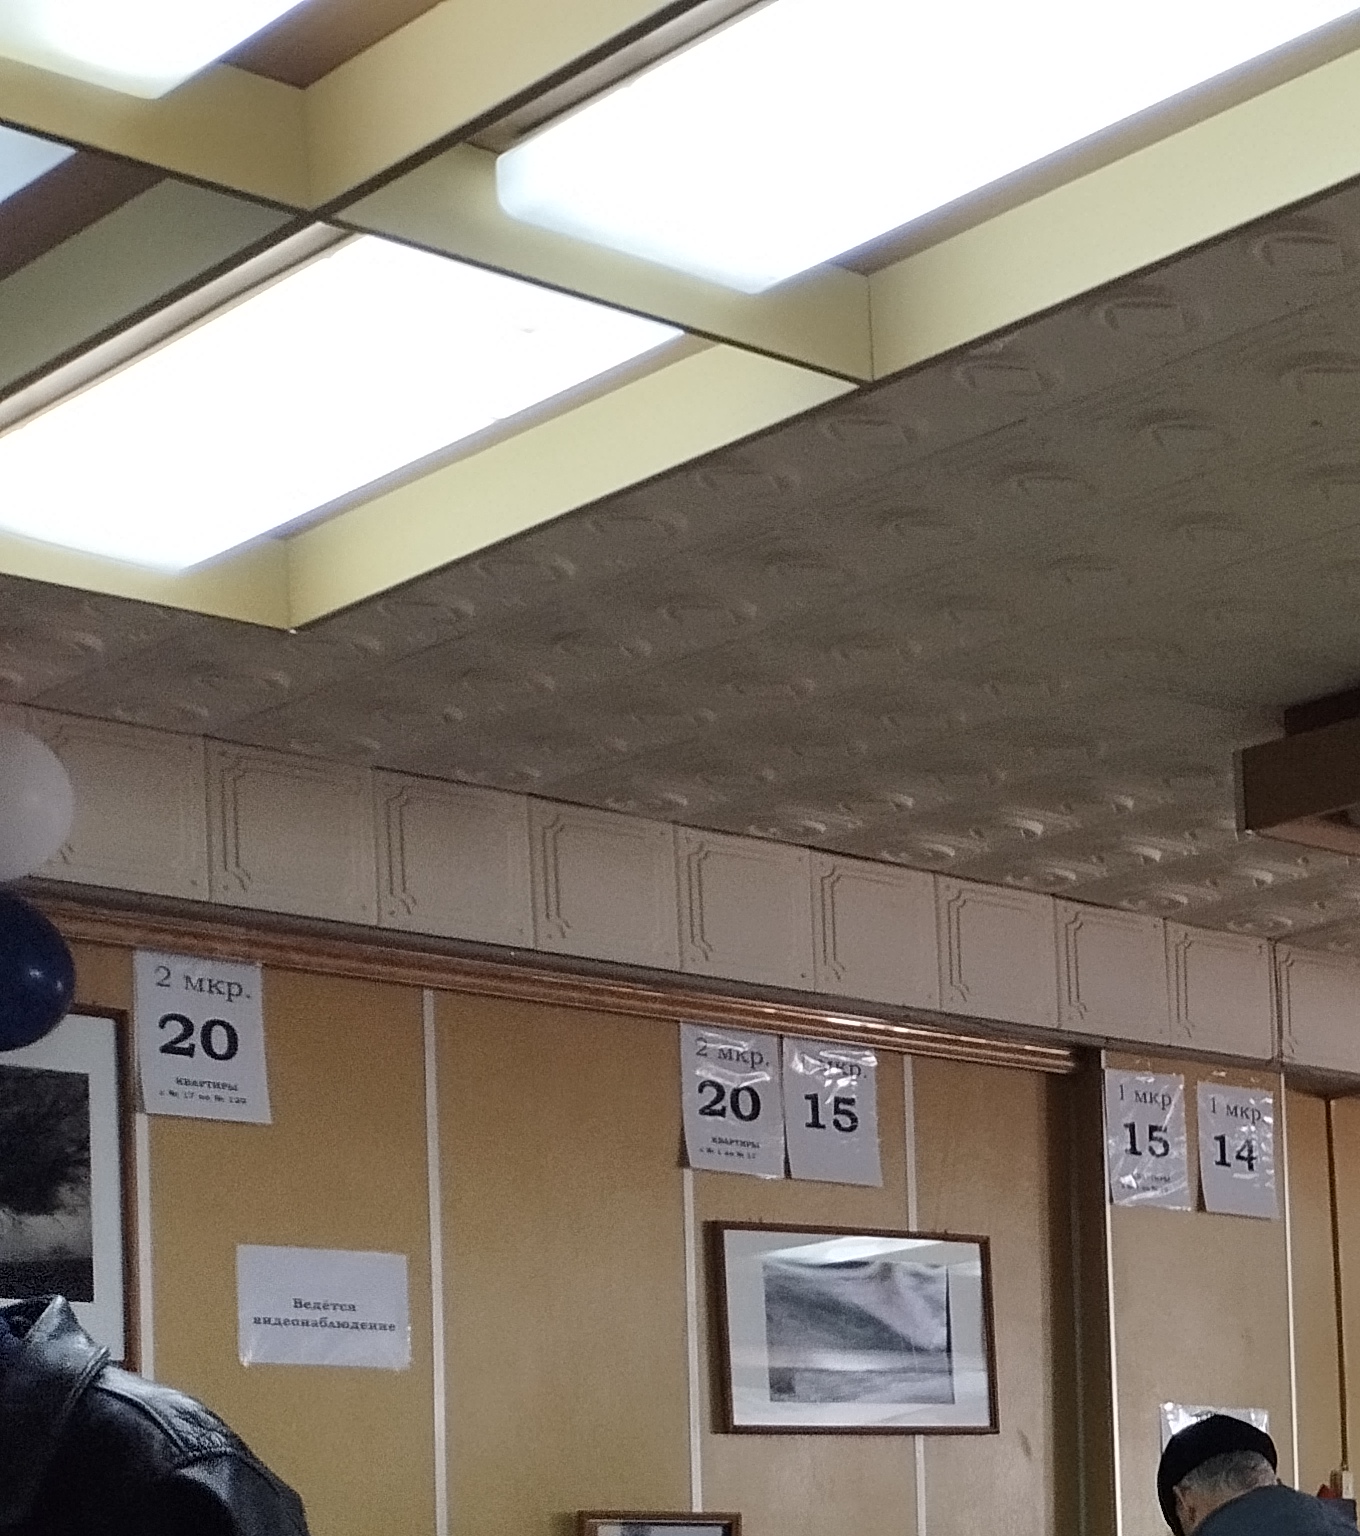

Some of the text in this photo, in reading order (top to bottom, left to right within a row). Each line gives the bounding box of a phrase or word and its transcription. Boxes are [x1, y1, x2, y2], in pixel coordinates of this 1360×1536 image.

[154, 965, 251, 1002] 2 мкр.
[158, 1013, 239, 1061] 20
[695, 1037, 770, 1070] 2 мкр.
[698, 1080, 761, 1122] 20
[1119, 1084, 1125, 1100] 1
[1210, 1097, 1216, 1114] 1
[804, 1093, 859, 1133] 15
[1123, 1121, 1170, 1158] 15
[1213, 1134, 1257, 1171] 14
[253, 1315, 397, 1332] видеонаблюдение
[293, 1297, 357, 1313] Ведётся
